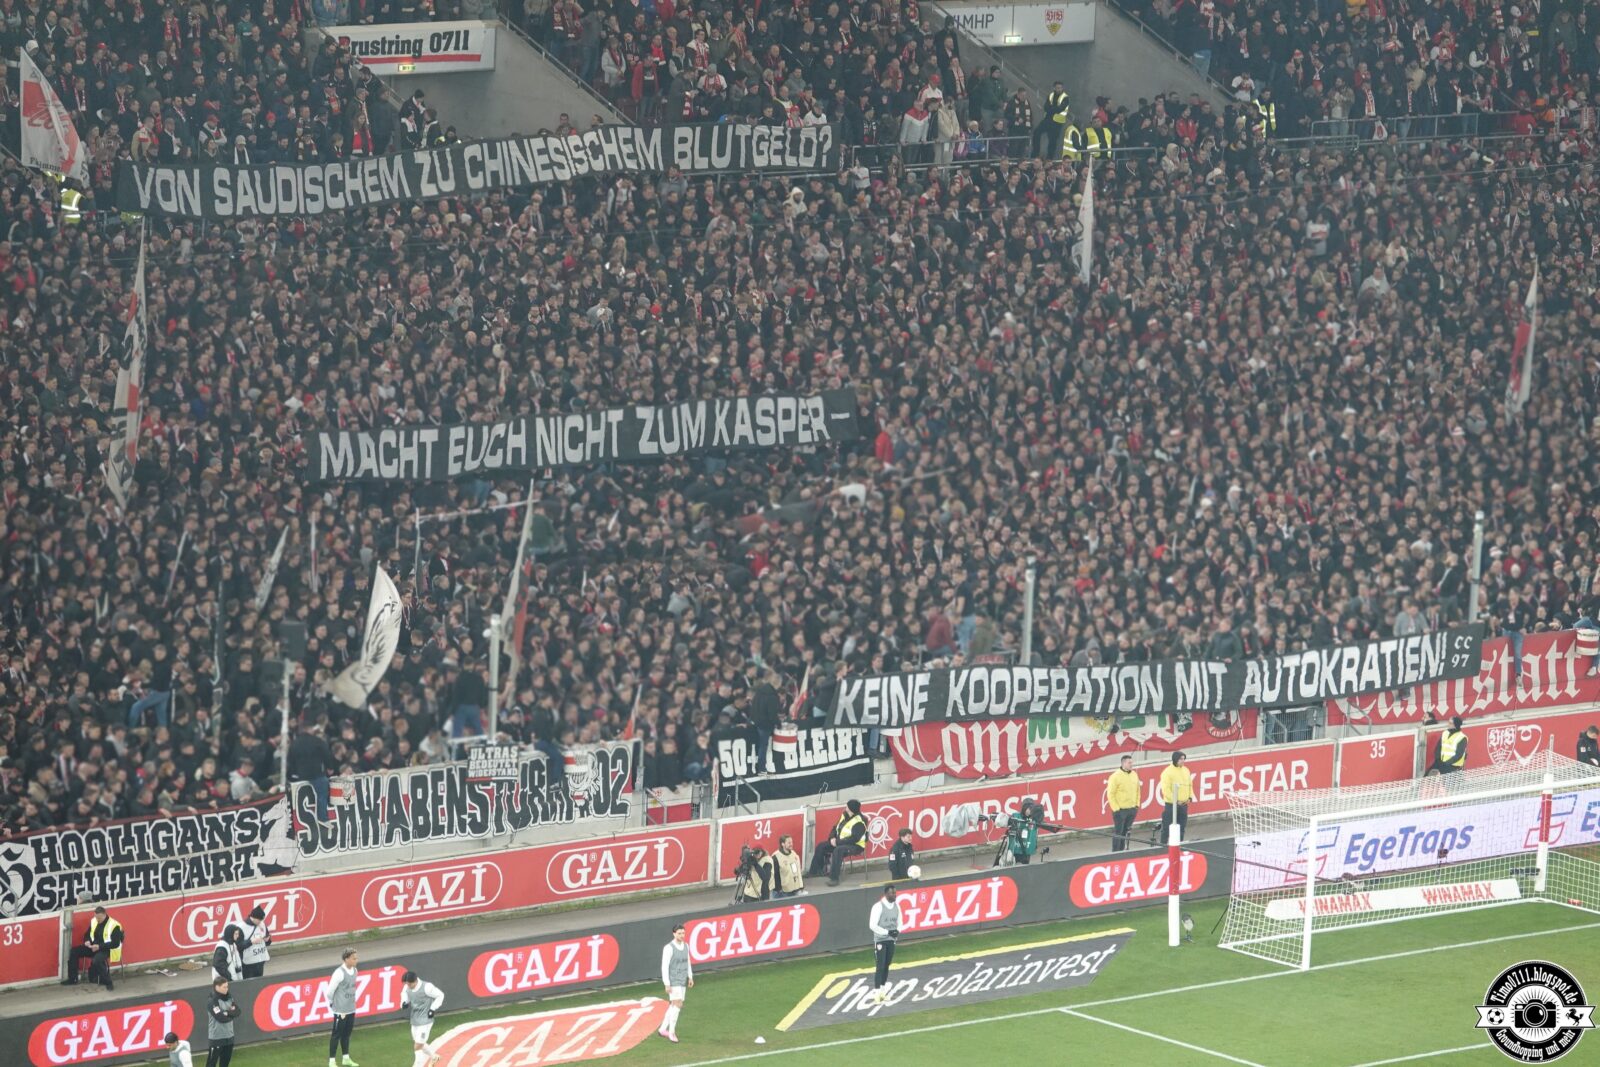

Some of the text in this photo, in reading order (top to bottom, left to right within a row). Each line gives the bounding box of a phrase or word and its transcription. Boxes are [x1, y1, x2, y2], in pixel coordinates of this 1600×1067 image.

[963, 13, 995, 29] MHP
[430, 29, 470, 53] 0711
[132, 124, 833, 216] VON SAUDISCHEM ZU CHINESISCHEM BLUTGELD?
[319, 429, 439, 479] MACHT
[448, 418, 527, 476] EUCH
[535, 409, 624, 467] NICHT
[635, 400, 706, 455] ZUM
[1454, 636, 1473, 650] CC
[1451, 653, 1470, 668] 97
[834, 632, 1447, 726] KEINE KOOPERATION MIT AUTOKRATIEN!
[471, 746, 518, 760] ULTRAS
[1370, 739, 1386, 759] 35
[470, 759, 517, 770] BEDEUTET
[29, 808, 262, 875] HOOLIGANS
[753, 820, 772, 840] 34
[1343, 825, 1475, 872] EgeTrans
[34, 843, 263, 914] STUTTGART
[1421, 882, 1495, 905] WINAMAX
[3, 924, 23, 946] 33
[912, 944, 1117, 1003] solarinvest
